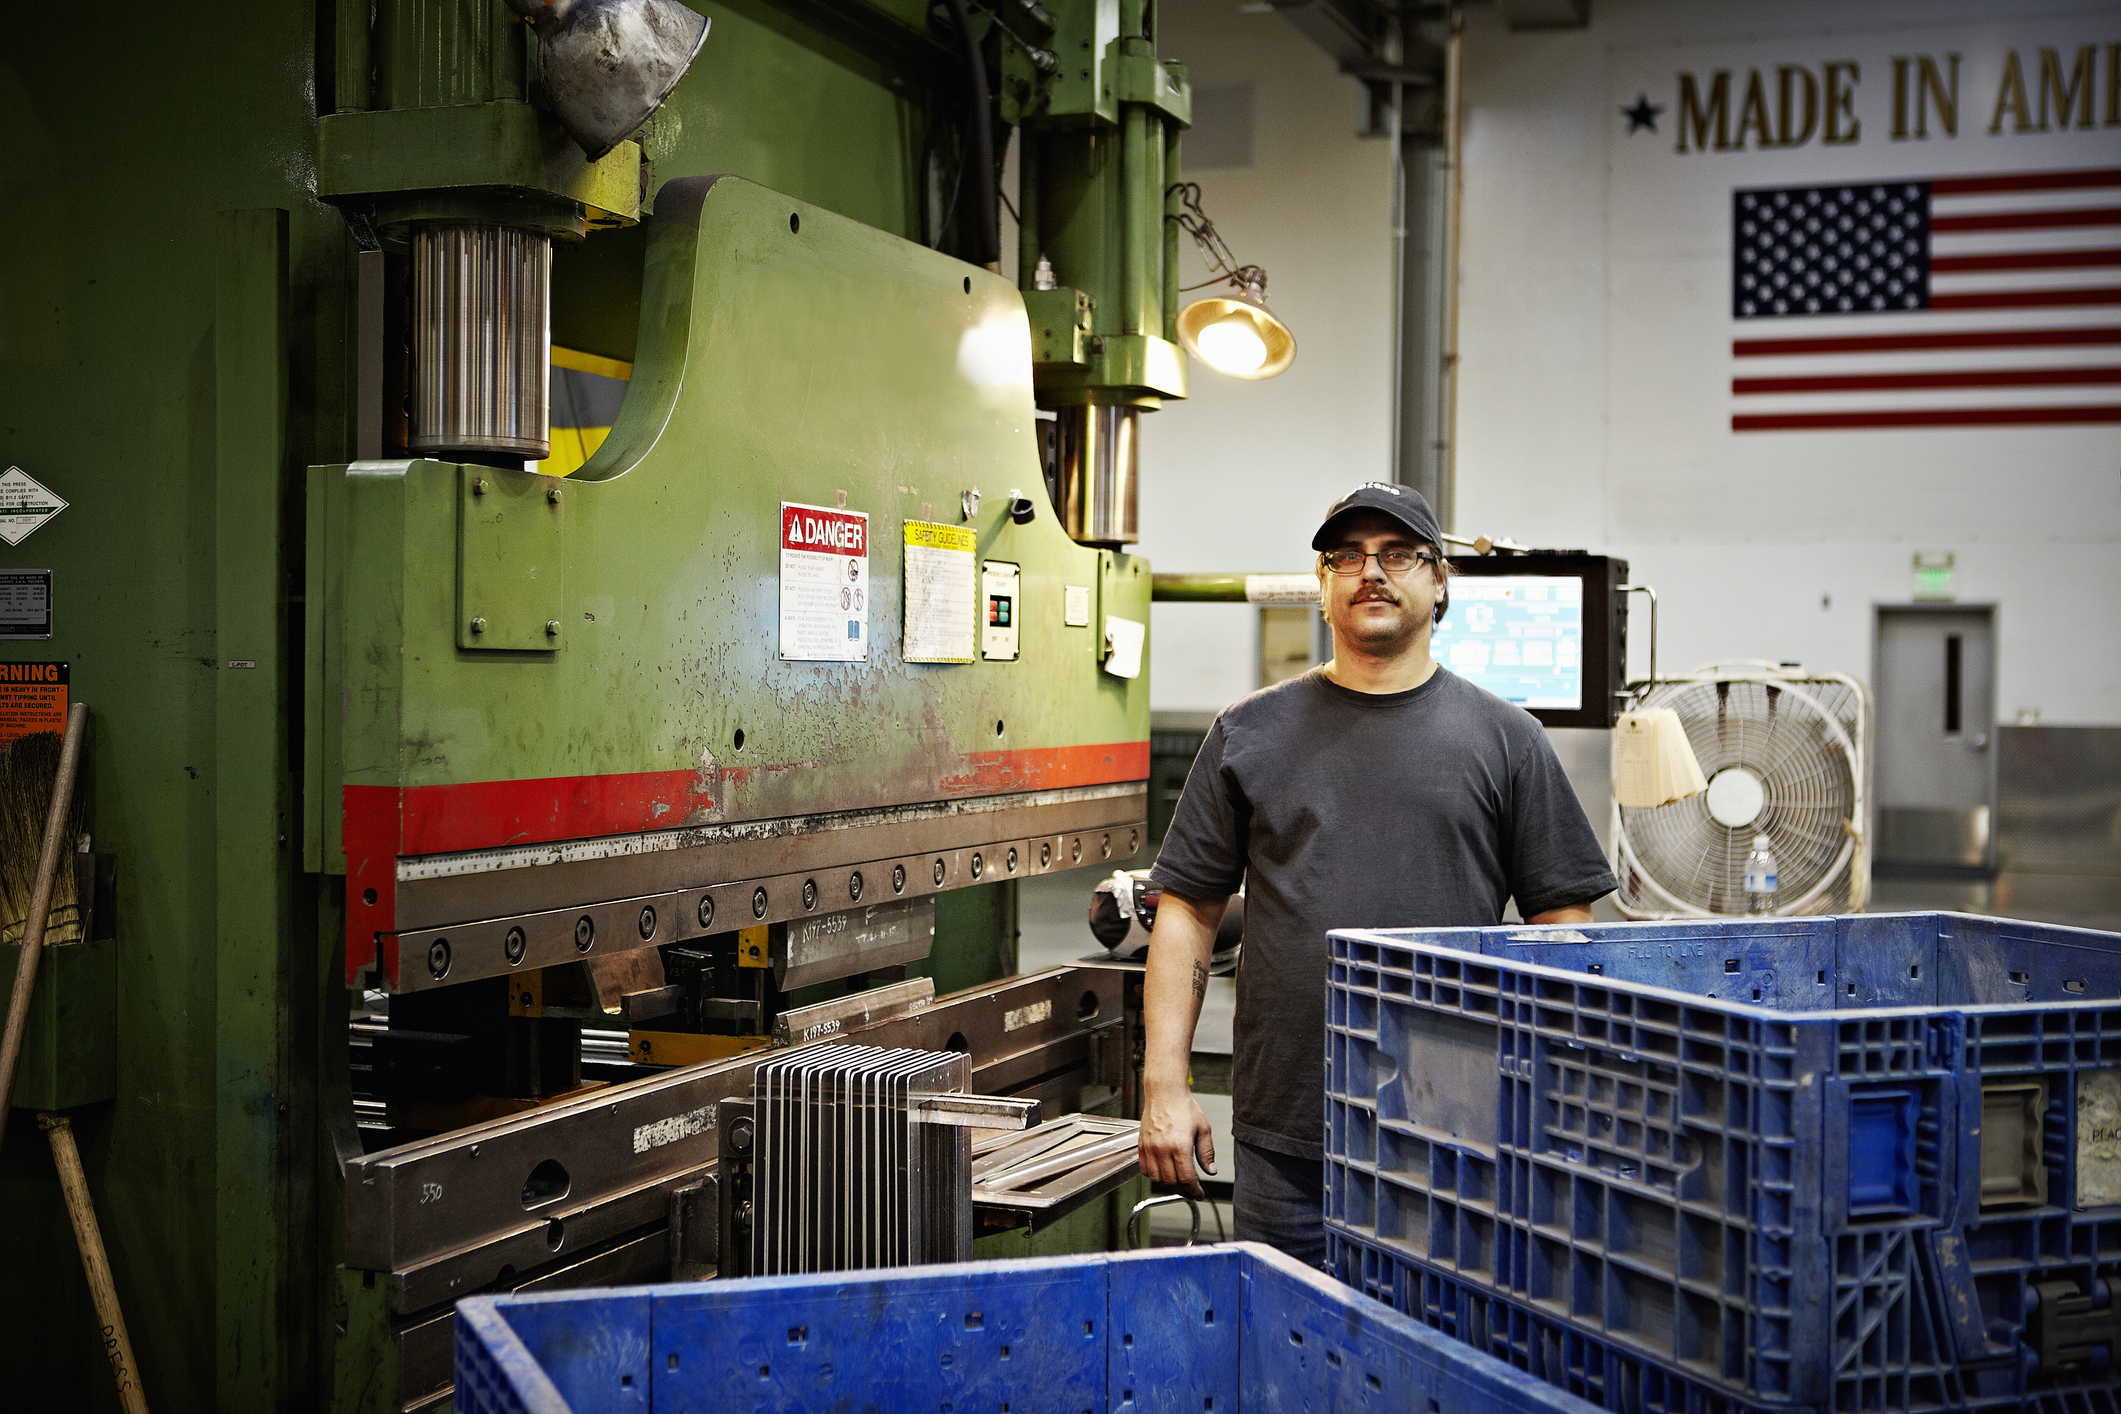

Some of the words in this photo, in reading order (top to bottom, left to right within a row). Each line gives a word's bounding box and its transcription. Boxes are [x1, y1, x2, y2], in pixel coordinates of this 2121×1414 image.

[1675, 61, 1861, 155] MADE
[1890, 52, 1963, 141] IN
[805, 517, 862, 550] DANGER
[915, 529, 937, 543] SAFETY
[803, 1020, 840, 1042] K197-5539
[420, 1183, 443, 1204] 550
[101, 1325, 132, 1393] PRESS
